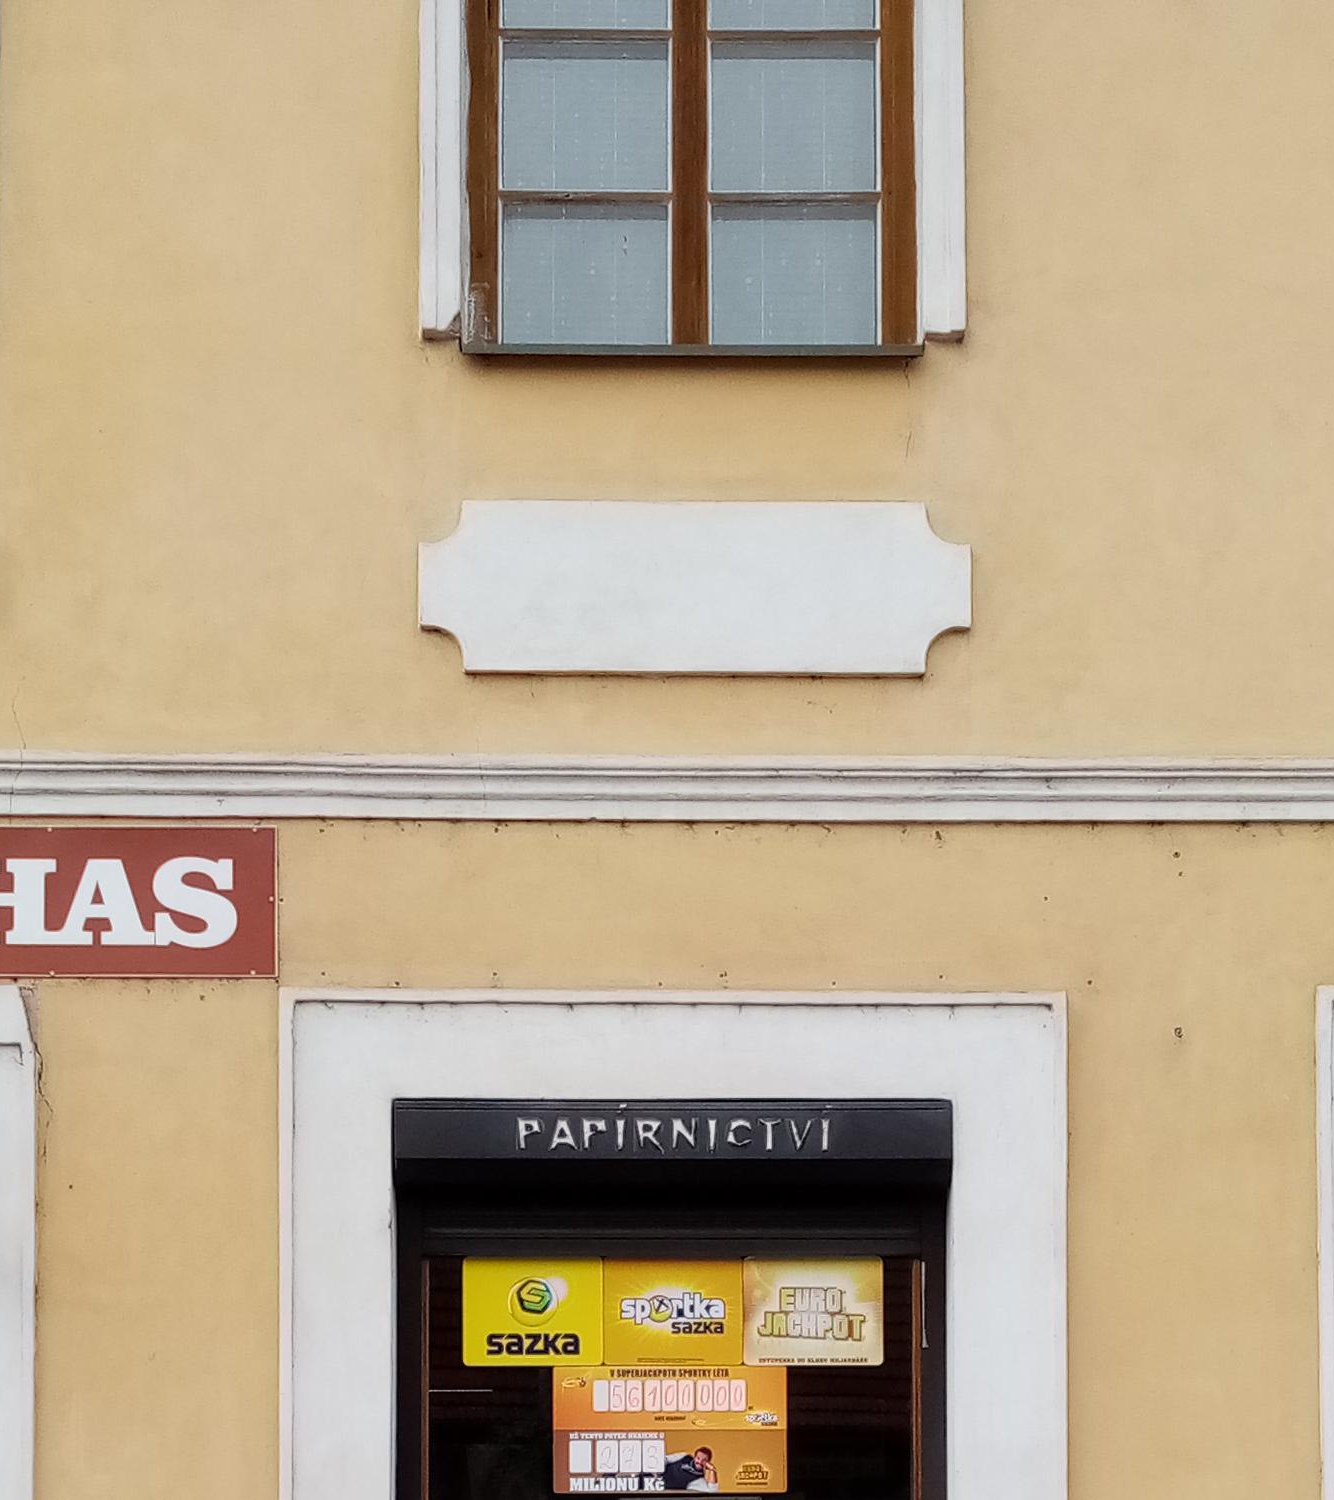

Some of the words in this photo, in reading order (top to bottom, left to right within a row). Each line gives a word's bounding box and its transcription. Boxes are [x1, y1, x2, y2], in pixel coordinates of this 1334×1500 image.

[779, 1287, 843, 1312] EURO
[757, 1311, 866, 1342] JACKPOT
[569, 1474, 640, 1492] MILIONŮ
[643, 1475, 665, 1492] Kč
